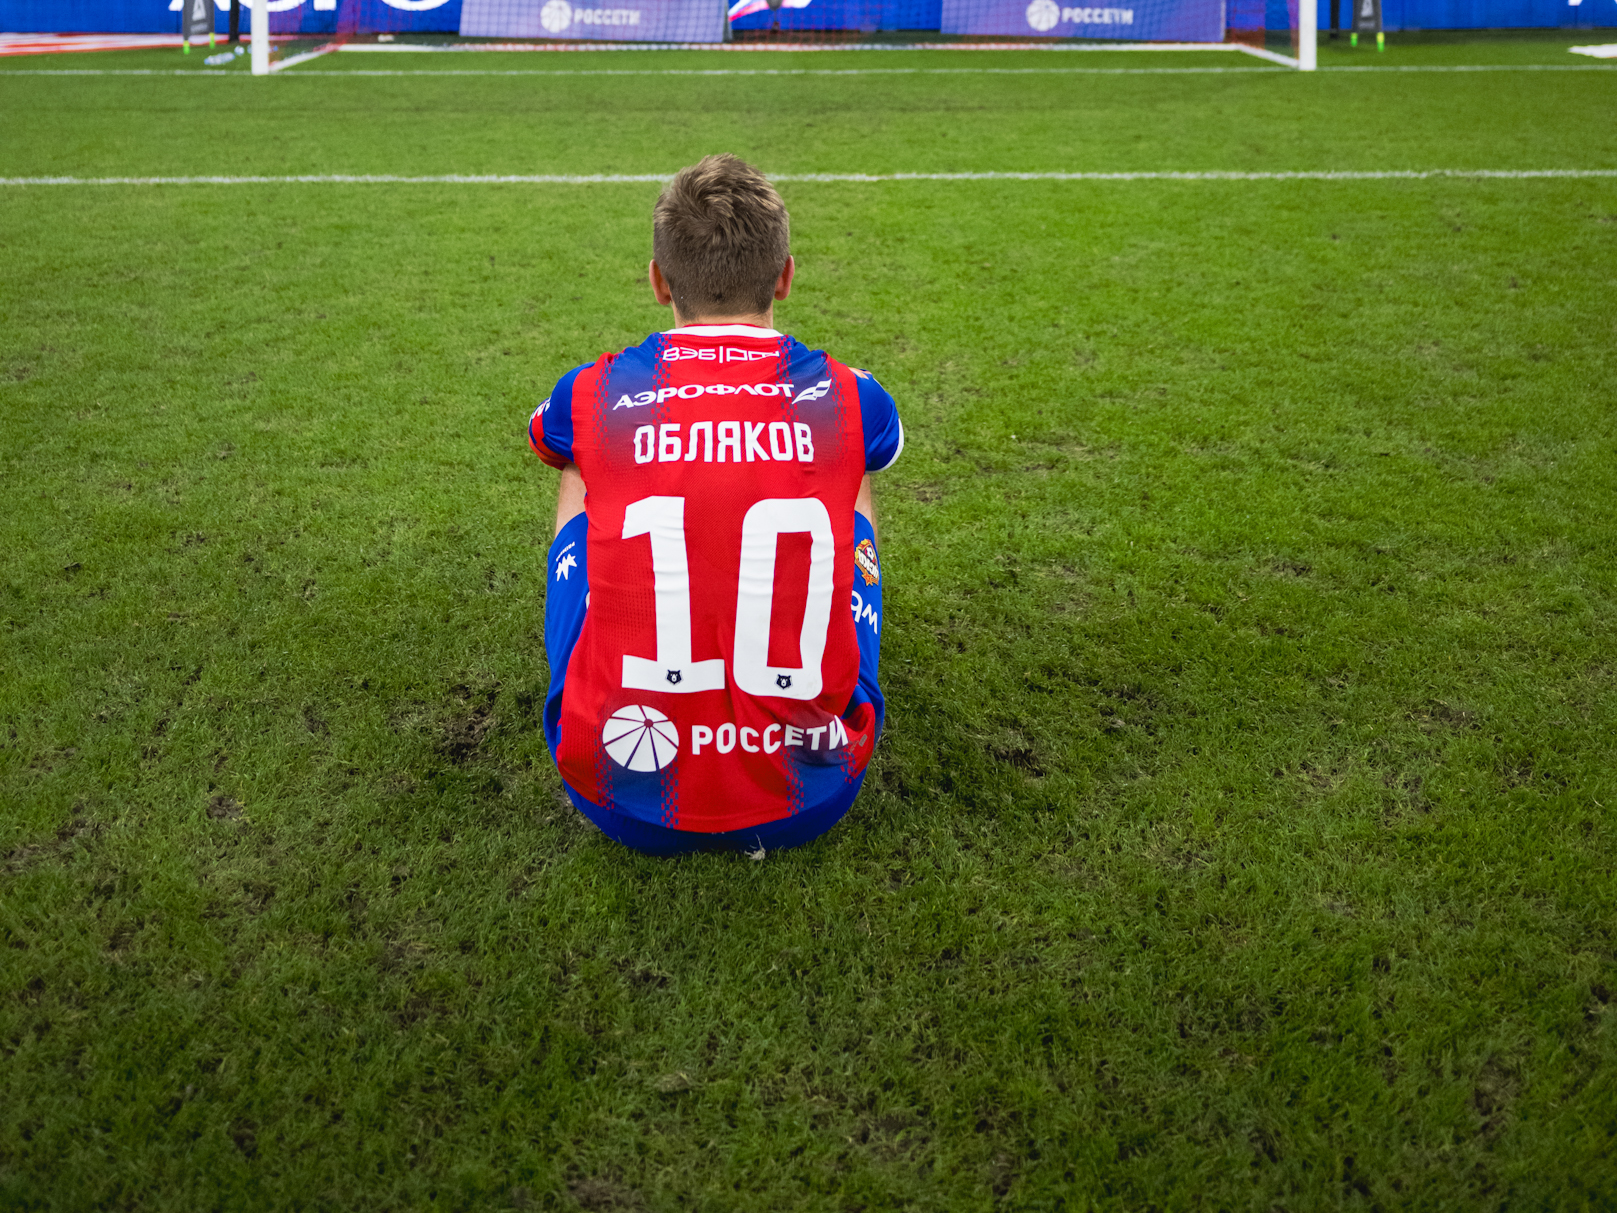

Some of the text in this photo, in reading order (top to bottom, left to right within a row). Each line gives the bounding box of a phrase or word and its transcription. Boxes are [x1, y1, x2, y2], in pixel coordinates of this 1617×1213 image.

[574, 8, 641, 25] РОССЕТИ
[1061, 7, 1134, 25] РОССЕТИ
[612, 382, 795, 410] АЭРОФЛОТ
[632, 420, 815, 464] ОБЛЯКОВ
[620, 495, 836, 701] 10
[691, 714, 849, 756] РОССЕТИ
